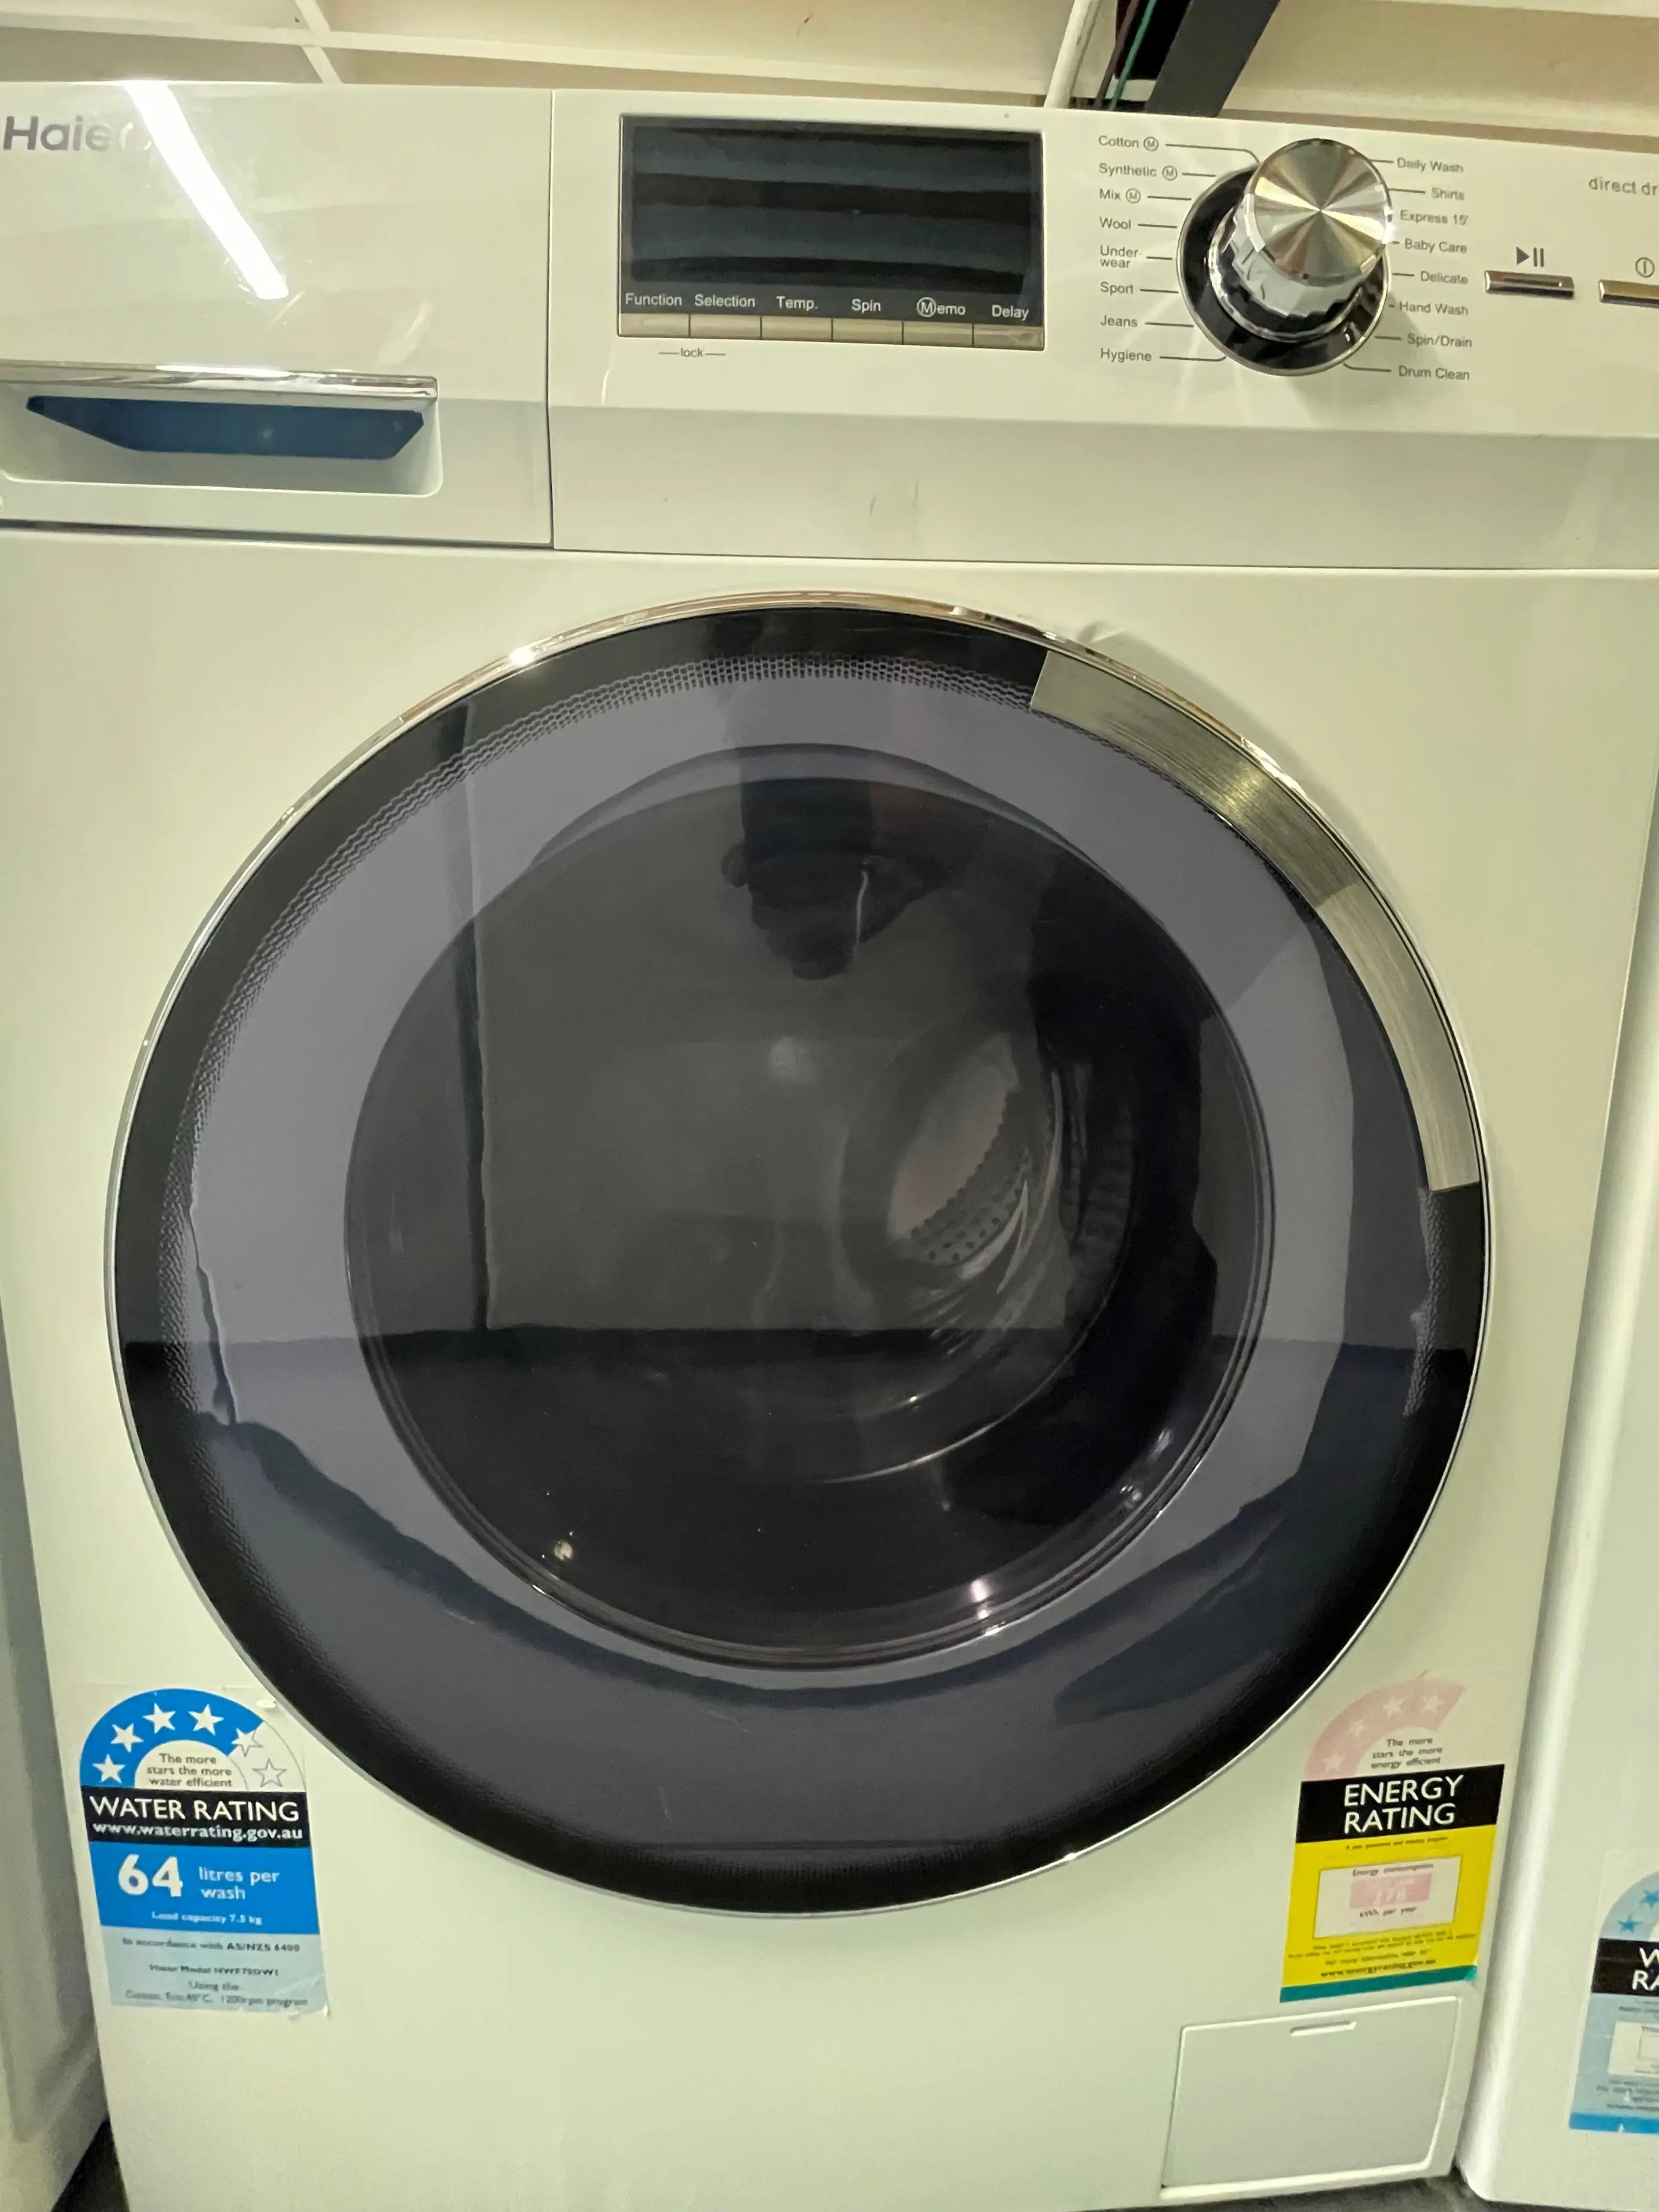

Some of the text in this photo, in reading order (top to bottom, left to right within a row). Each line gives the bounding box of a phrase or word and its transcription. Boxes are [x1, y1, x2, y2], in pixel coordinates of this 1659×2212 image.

[1099, 135, 1139, 148] Cotton
[1099, 163, 1156, 178] Synthetic
[1397, 158, 1463, 174] Daily Wash
[1431, 187, 1464, 200] Shirts
[1589, 177, 1637, 195] direct
[1099, 189, 1121, 200] Mix
[1100, 217, 1131, 230] Wool
[1400, 209, 1448, 224] Express
[1405, 238, 1467, 254] Baby Care
[1100, 259, 1130, 269] wear
[1421, 271, 1468, 285] Delicate
[1100, 281, 1134, 297] Sport
[625, 292, 682, 307] Function
[694, 293, 756, 308] Selection
[776, 296, 818, 311] Temp.
[852, 298, 882, 314] Spin
[991, 305, 1029, 321] Delay
[1399, 301, 1469, 317] Hand Wash
[1100, 315, 1138, 328] Jeans
[1407, 333, 1472, 348] Spin/Drain
[680, 347, 704, 358] lock
[1100, 348, 1151, 364] Hygiene
[1399, 365, 1470, 381] Drum Clean
[1387, 1737, 1433, 1748] The more
[159, 1753, 217, 1764] The more
[1372, 1746, 1443, 1759] stars the more
[1371, 1757, 1441, 1770] energy efficient
[147, 1766, 232, 1777] stars the more
[148, 1777, 233, 1788] water efficient
[1344, 1775, 1464, 1807] ENERGY
[90, 1795, 300, 1822] WATER RATING
[1344, 1803, 1457, 1834] RATING
[93, 1822, 303, 1842] www.waterrating.gov.au
[118, 1854, 184, 1897] 64
[198, 1866, 281, 1886] litres per
[200, 1886, 246, 1900] wash
